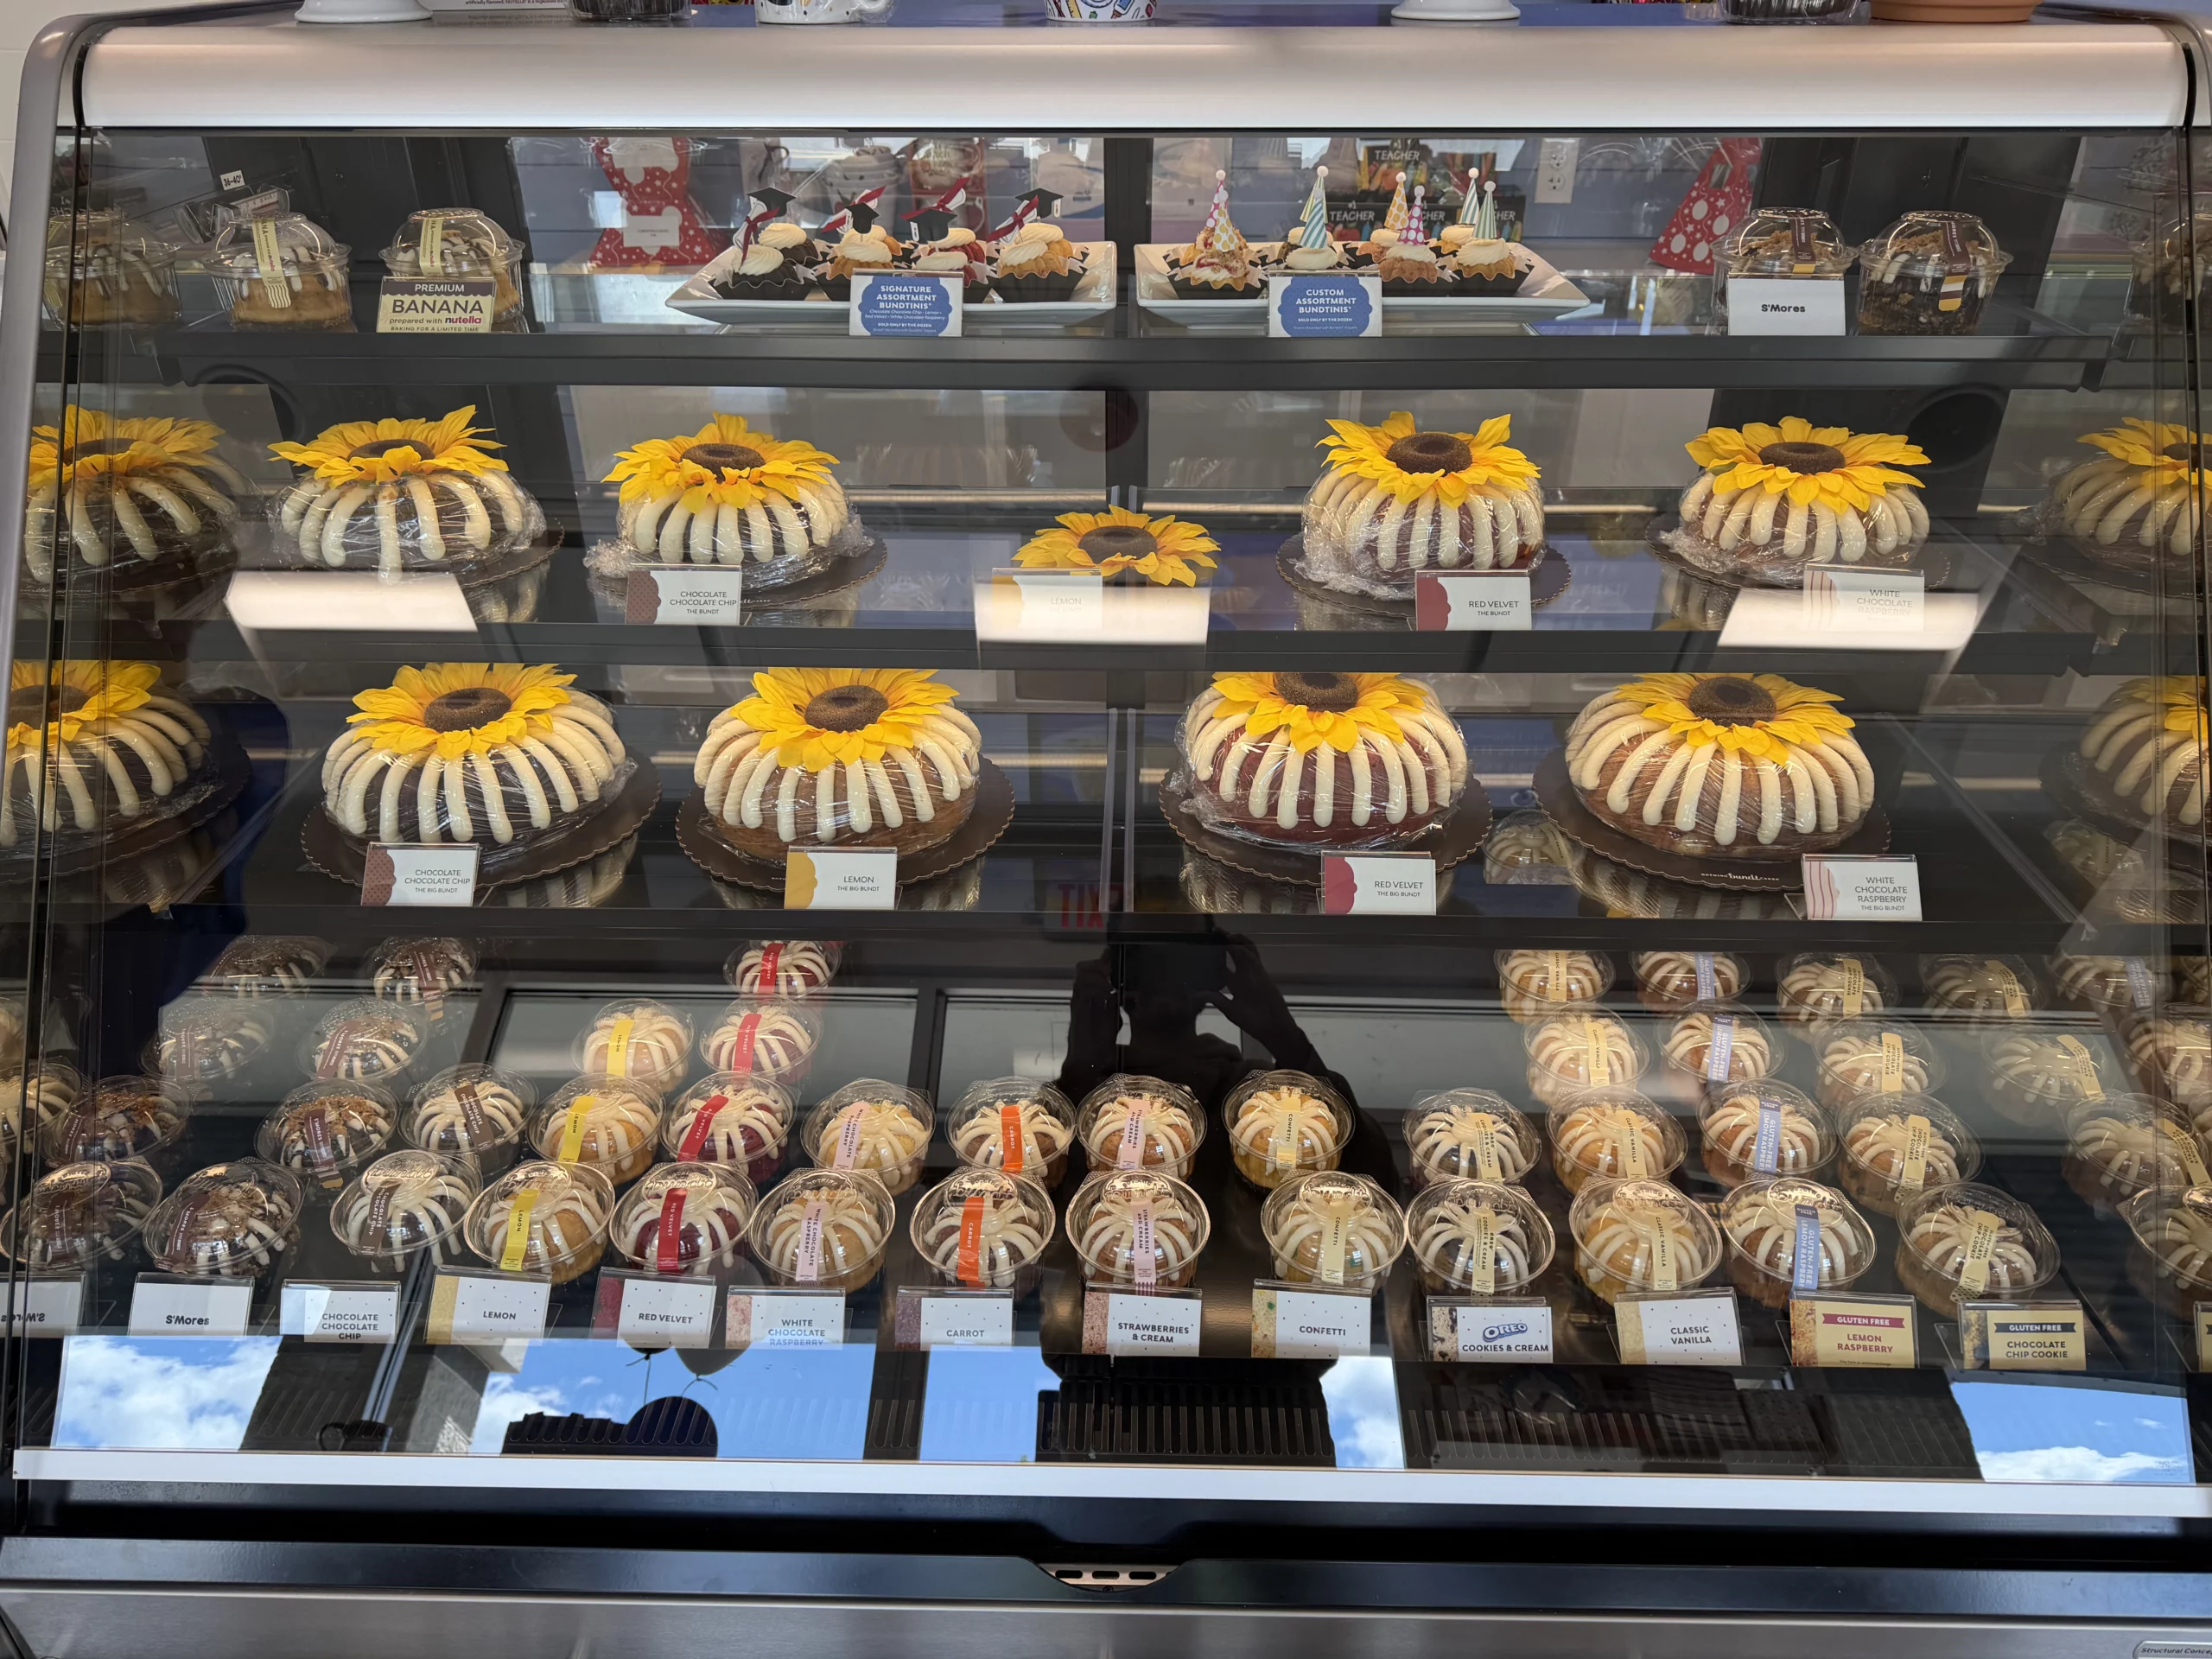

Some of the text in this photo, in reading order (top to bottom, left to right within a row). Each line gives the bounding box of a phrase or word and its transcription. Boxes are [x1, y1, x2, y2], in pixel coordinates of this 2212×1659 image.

[1375, 149, 1420, 161] TEACHER
[1329, 211, 1375, 221] TEACHER
[392, 299, 483, 314] BANANA
[1761, 303, 1806, 313] S'Mores
[1870, 588, 1900, 598] WHITE
[1857, 598, 1912, 607] CHOCOLATE
[1859, 607, 1911, 617] RASPBERRY
[1719, 1032, 1728, 1081] GLUTEN-FREE
[1762, 1111, 1770, 1135] LEMON
[846, 1123, 857, 1159] CHOCOLATE
[1764, 1120, 1777, 1169] GLUTEN-FREE
[1914, 1129, 1923, 1161] CHOCOLATE
[376, 1192, 390, 1228] CHOCOLATE
[1332, 1217, 1341, 1246] CONFETTI
[1656, 1217, 1665, 1238] CLASSIC
[804, 1217, 812, 1254] RASPBERRY
[809, 1227, 817, 1267] CHOCOLATE
[1970, 1236, 1980, 1260] COOKIE
[1976, 1226, 1988, 1261] CHOCOLATE
[1805, 1230, 1815, 1285] GLUTEN-FREE
[165, 1315, 210, 1326] S'Mores
[321, 1313, 379, 1322] CHOCOLATE
[483, 1310, 517, 1320] LEMON
[639, 1313, 693, 1324] RED VELVET
[1836, 1315, 1891, 1326] GLUTEN FREE
[321, 1322, 378, 1332] CHOCOLATE
[1117, 1322, 1190, 1334] STRAWBERRIES
[1299, 1325, 1346, 1337] CONFETTI
[1482, 1322, 1528, 1343] OREO
[1670, 1325, 1710, 1336] CLASSIC
[2008, 1323, 2063, 1332] GLUTEN FREE
[338, 1332, 362, 1341] CHIP
[767, 1329, 826, 1338] CHOCOLATE
[1141, 1334, 1174, 1344] CREAM
[1847, 1333, 1883, 1343] LEMON
[769, 1338, 823, 1347] RASPBERRY
[1670, 1336, 1712, 1345] VANILLA
[2006, 1339, 2066, 1350] CHOCOLATE
[1837, 1342, 1894, 1354] RASPBERRY
[2005, 1350, 2069, 1359] CHIP COOKIE
